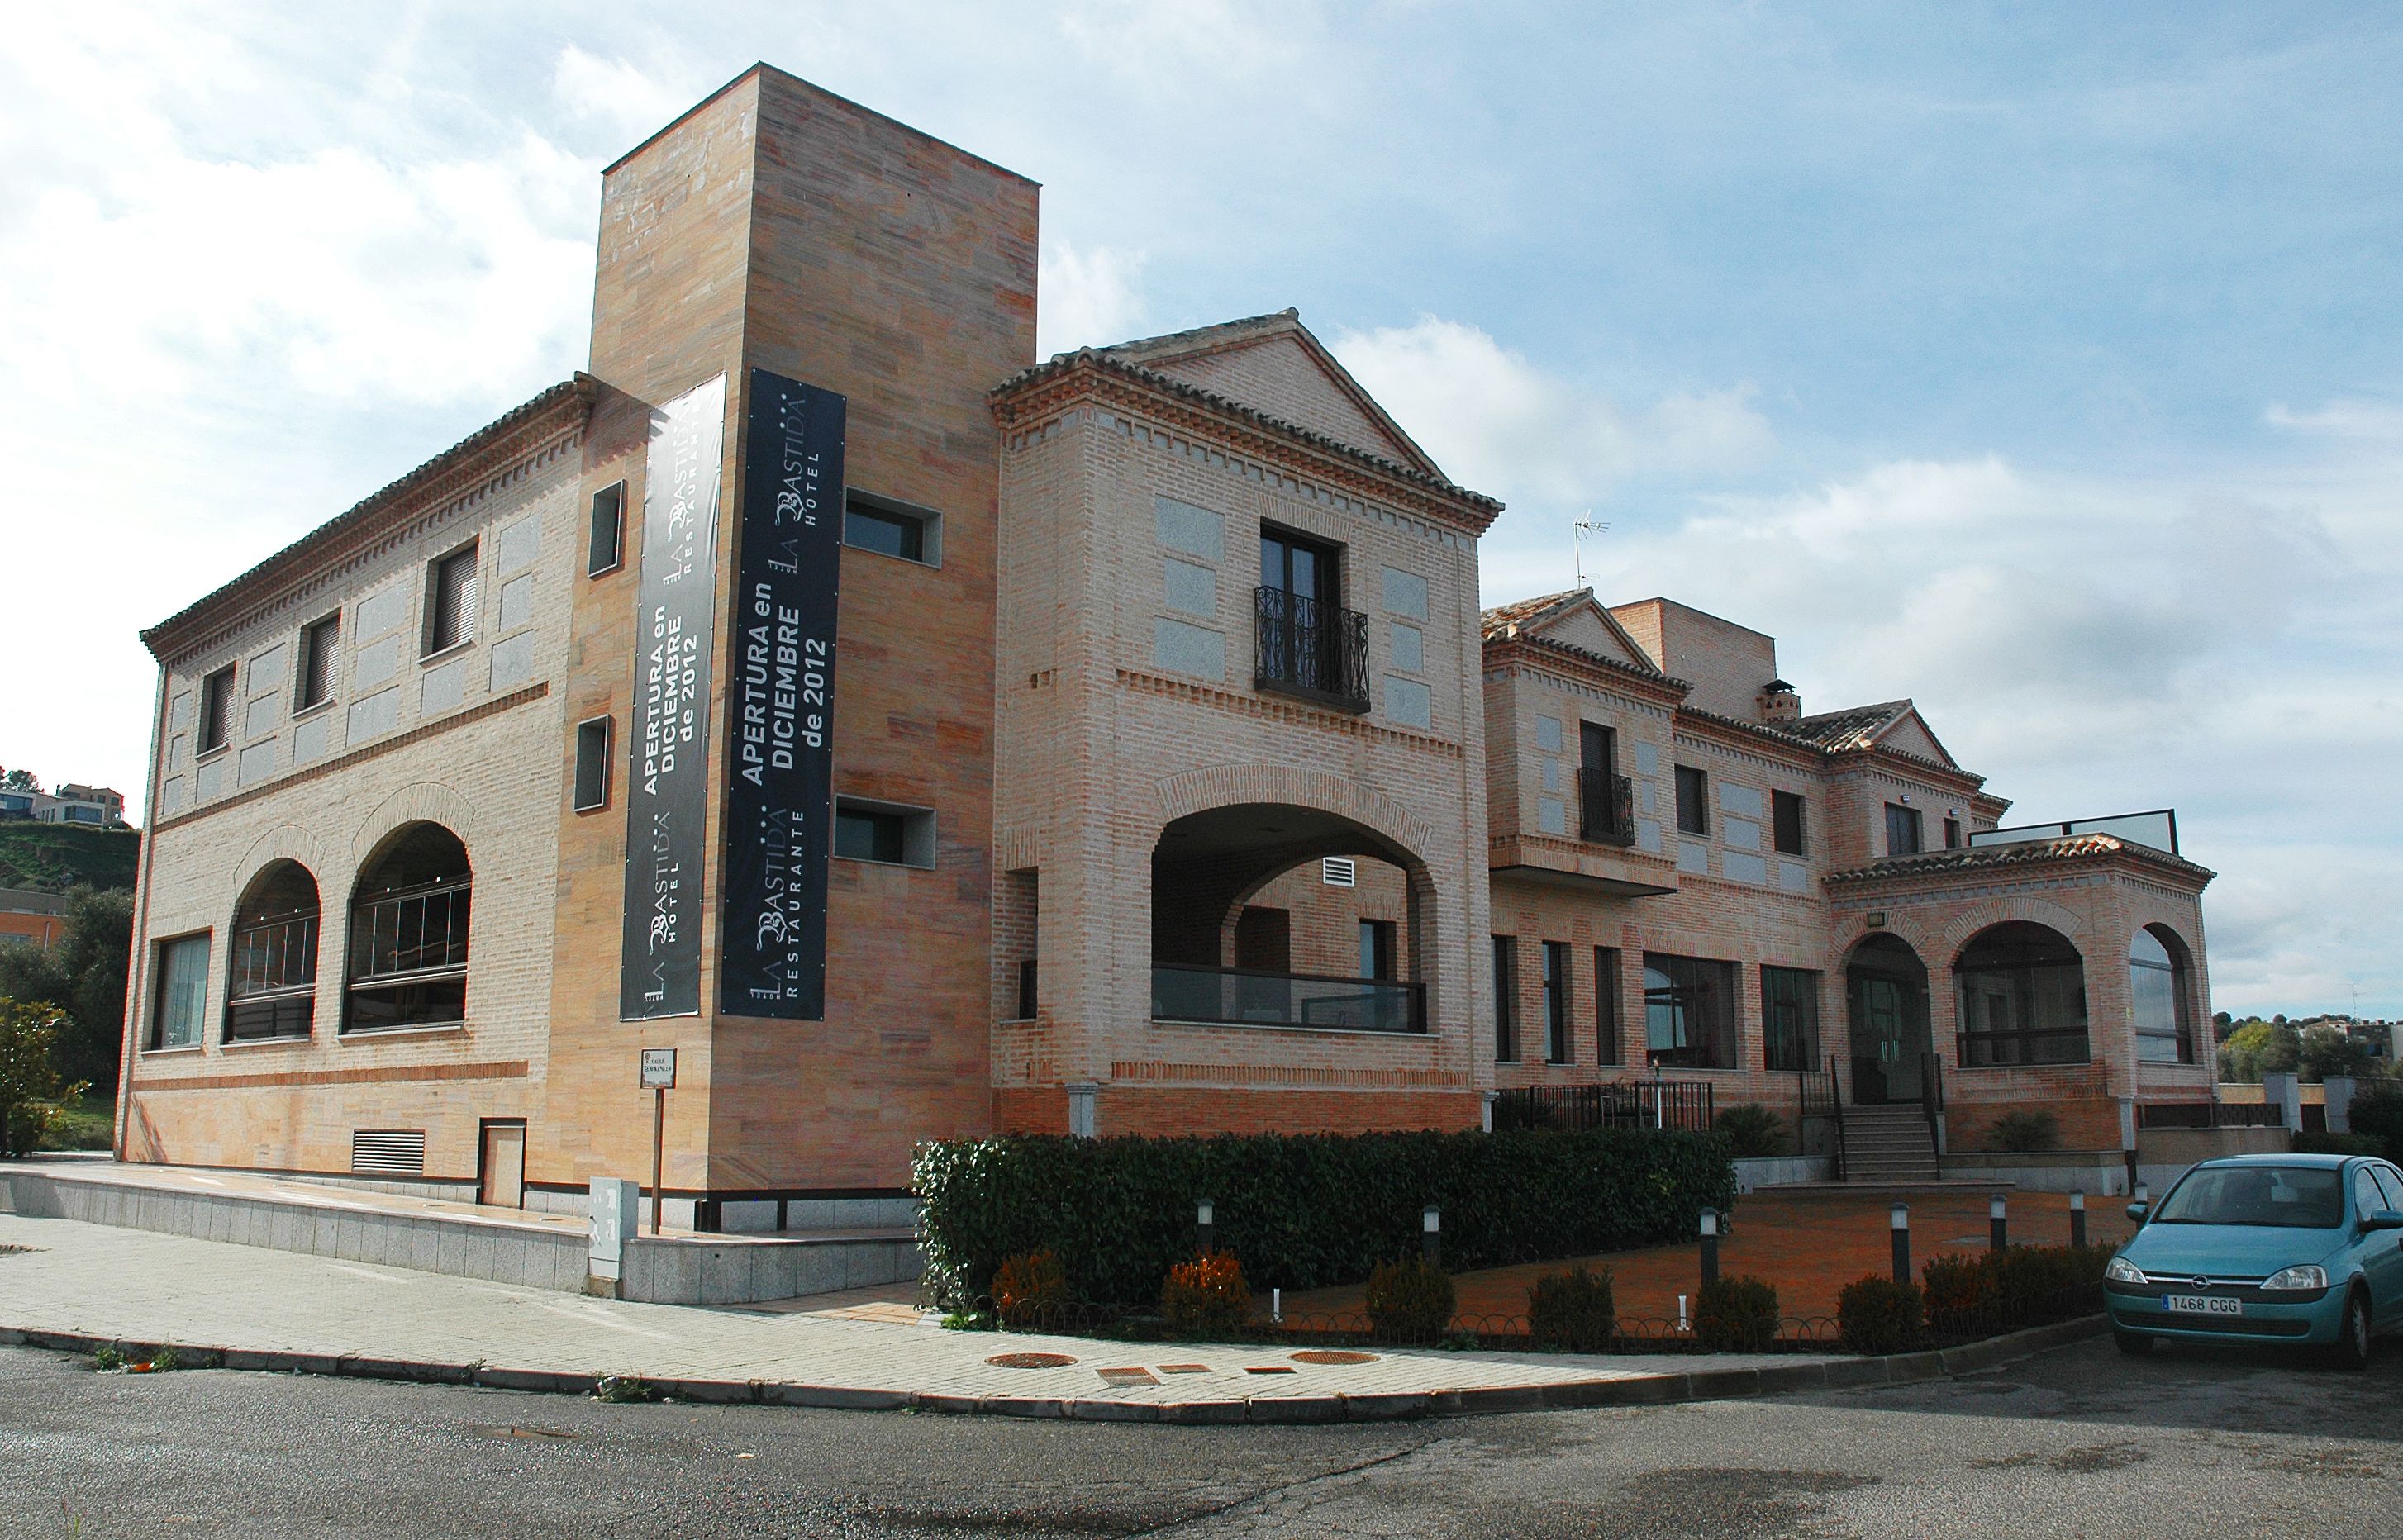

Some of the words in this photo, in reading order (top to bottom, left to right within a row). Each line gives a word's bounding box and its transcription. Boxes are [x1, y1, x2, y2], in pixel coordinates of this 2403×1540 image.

[669, 408, 690, 543] BASTIDA
[683, 402, 701, 575] RESTAURANTE
[776, 399, 807, 526] BASTIDA
[805, 453, 820, 526] HOTEL
[755, 582, 772, 617] en
[644, 644, 664, 796] APERTURA
[654, 606, 665, 639] en
[661, 616, 681, 773] DICIEMBRE
[680, 708, 694, 743] de
[682, 635, 697, 701] 2012
[742, 625, 769, 786] APERTURA
[772, 605, 799, 770] DICIEMBRE
[802, 713, 822, 748] de
[804, 638, 826, 706] 2012
[649, 810, 670, 956] BASTIDA
[668, 862, 679, 943] HOTEL
[756, 809, 788, 950] BASTIDA
[787, 811, 804, 998] RESTAURANTE
[2172, 1296, 2205, 1311] 1468
[2210, 1299, 2238, 1313] CGG
